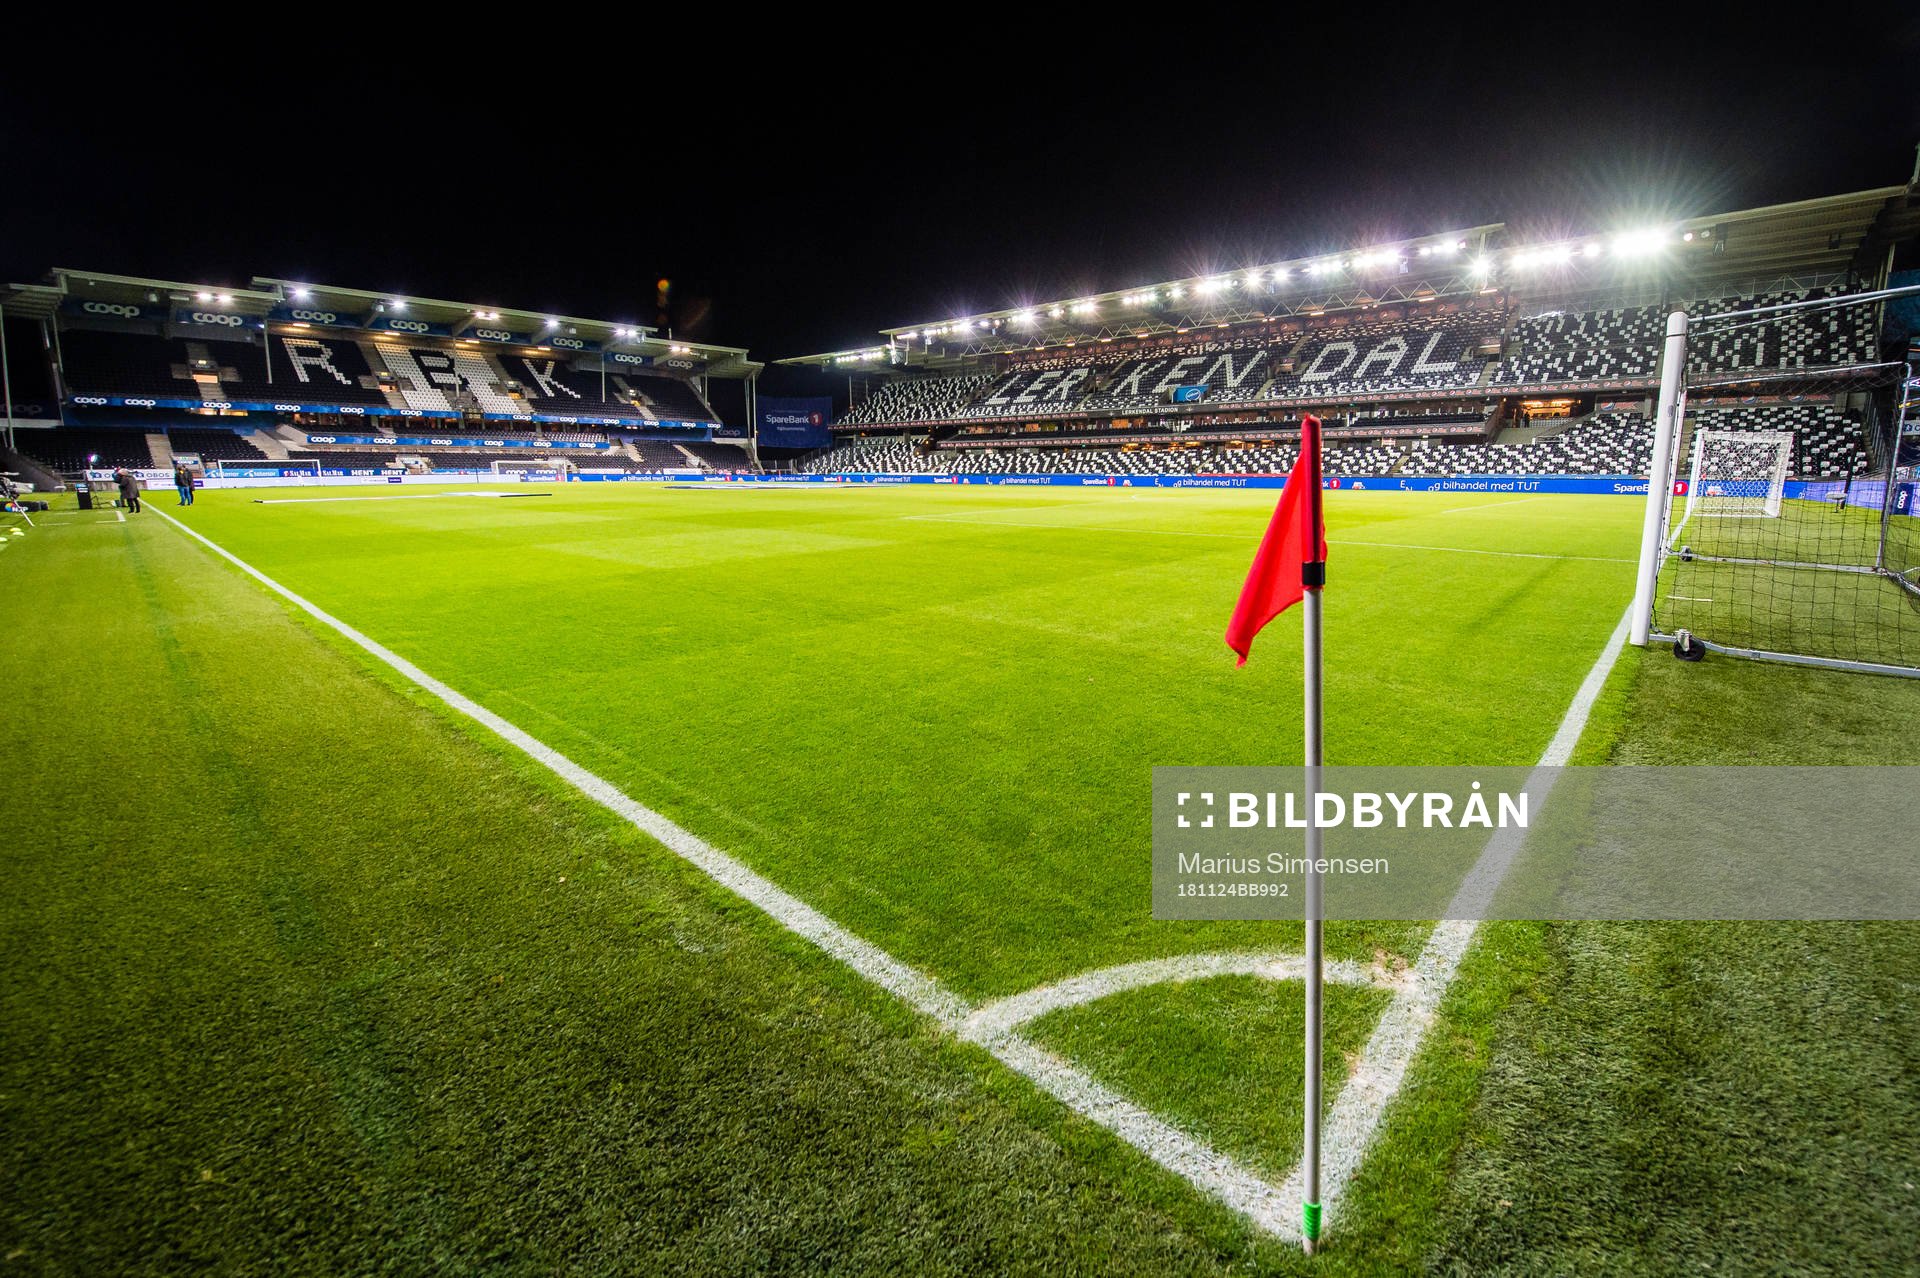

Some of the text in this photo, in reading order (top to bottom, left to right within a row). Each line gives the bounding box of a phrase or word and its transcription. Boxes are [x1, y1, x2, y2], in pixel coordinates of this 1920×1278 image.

[83, 302, 140, 319] coop
[292, 309, 336, 324] coop
[192, 312, 243, 327] coop
[389, 319, 429, 333] coop
[476, 328, 511, 342] coop
[552, 337, 584, 350] coop
[614, 353, 643, 366] coop
[667, 359, 693, 370] coop
[74, 396, 107, 405] coop
[124, 398, 156, 407] coop
[203, 401, 231, 410] coop
[274, 404, 301, 412] coop
[340, 406, 364, 415] coop
[400, 409, 423, 417] coop
[560, 416, 577, 424] coop
[766, 414, 809, 424] SpareBank
[311, 436, 336, 444] coop
[373, 437, 397, 445] coop
[1082, 478, 1107, 486] SpareBank
[1183, 478, 1213, 487] bilhandel
[1214, 479, 1230, 487] med
[1232, 479, 1247, 487] TUT
[1443, 480, 1488, 490] bilhandel
[1490, 481, 1514, 491] med
[1517, 481, 1540, 491] TUT
[1613, 483, 1650, 493] SpareB
